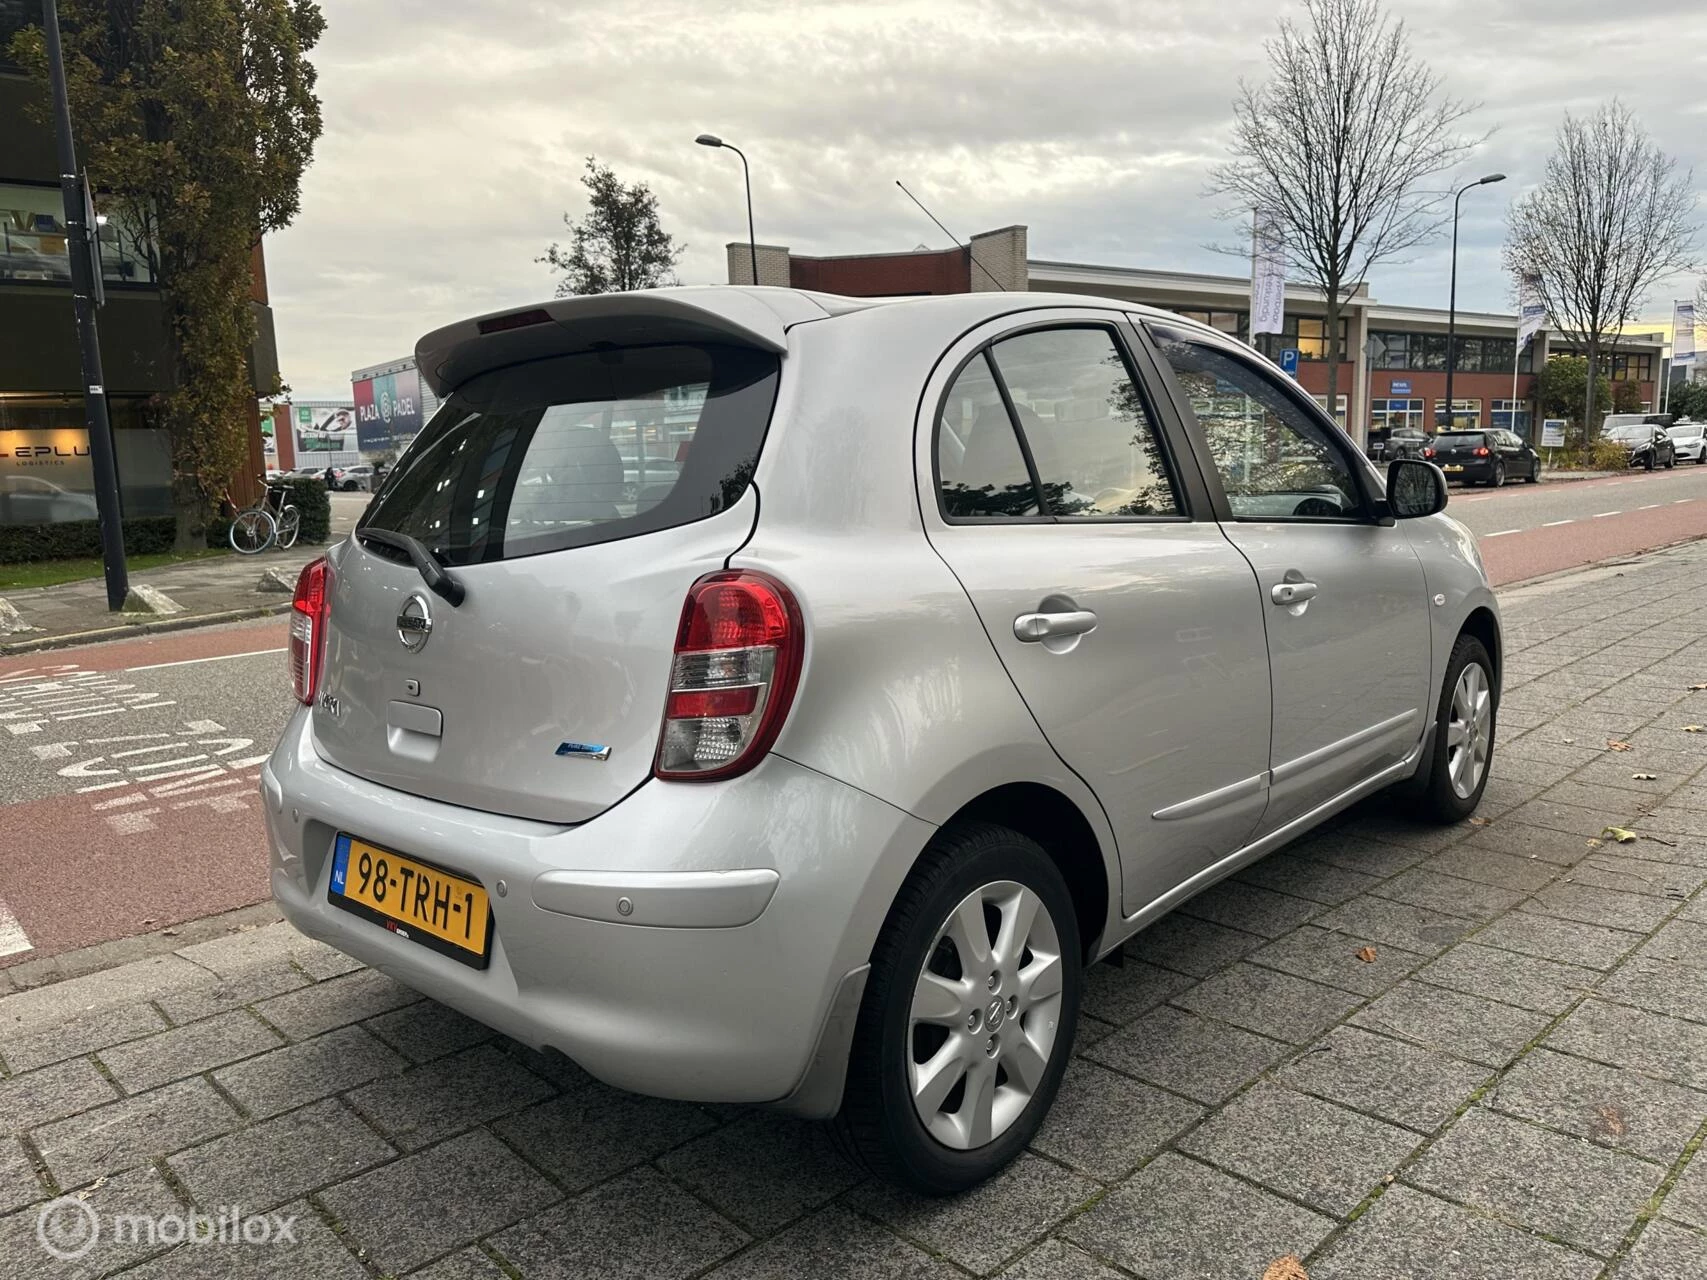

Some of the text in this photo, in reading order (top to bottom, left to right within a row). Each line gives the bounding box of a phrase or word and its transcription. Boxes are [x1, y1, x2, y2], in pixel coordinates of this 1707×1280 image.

[1283, 351, 1294, 366] P
[359, 397, 415, 422] PLAZA PADEL
[334, 870, 345, 885] NL
[358, 852, 473, 940] 98-TRH-1
